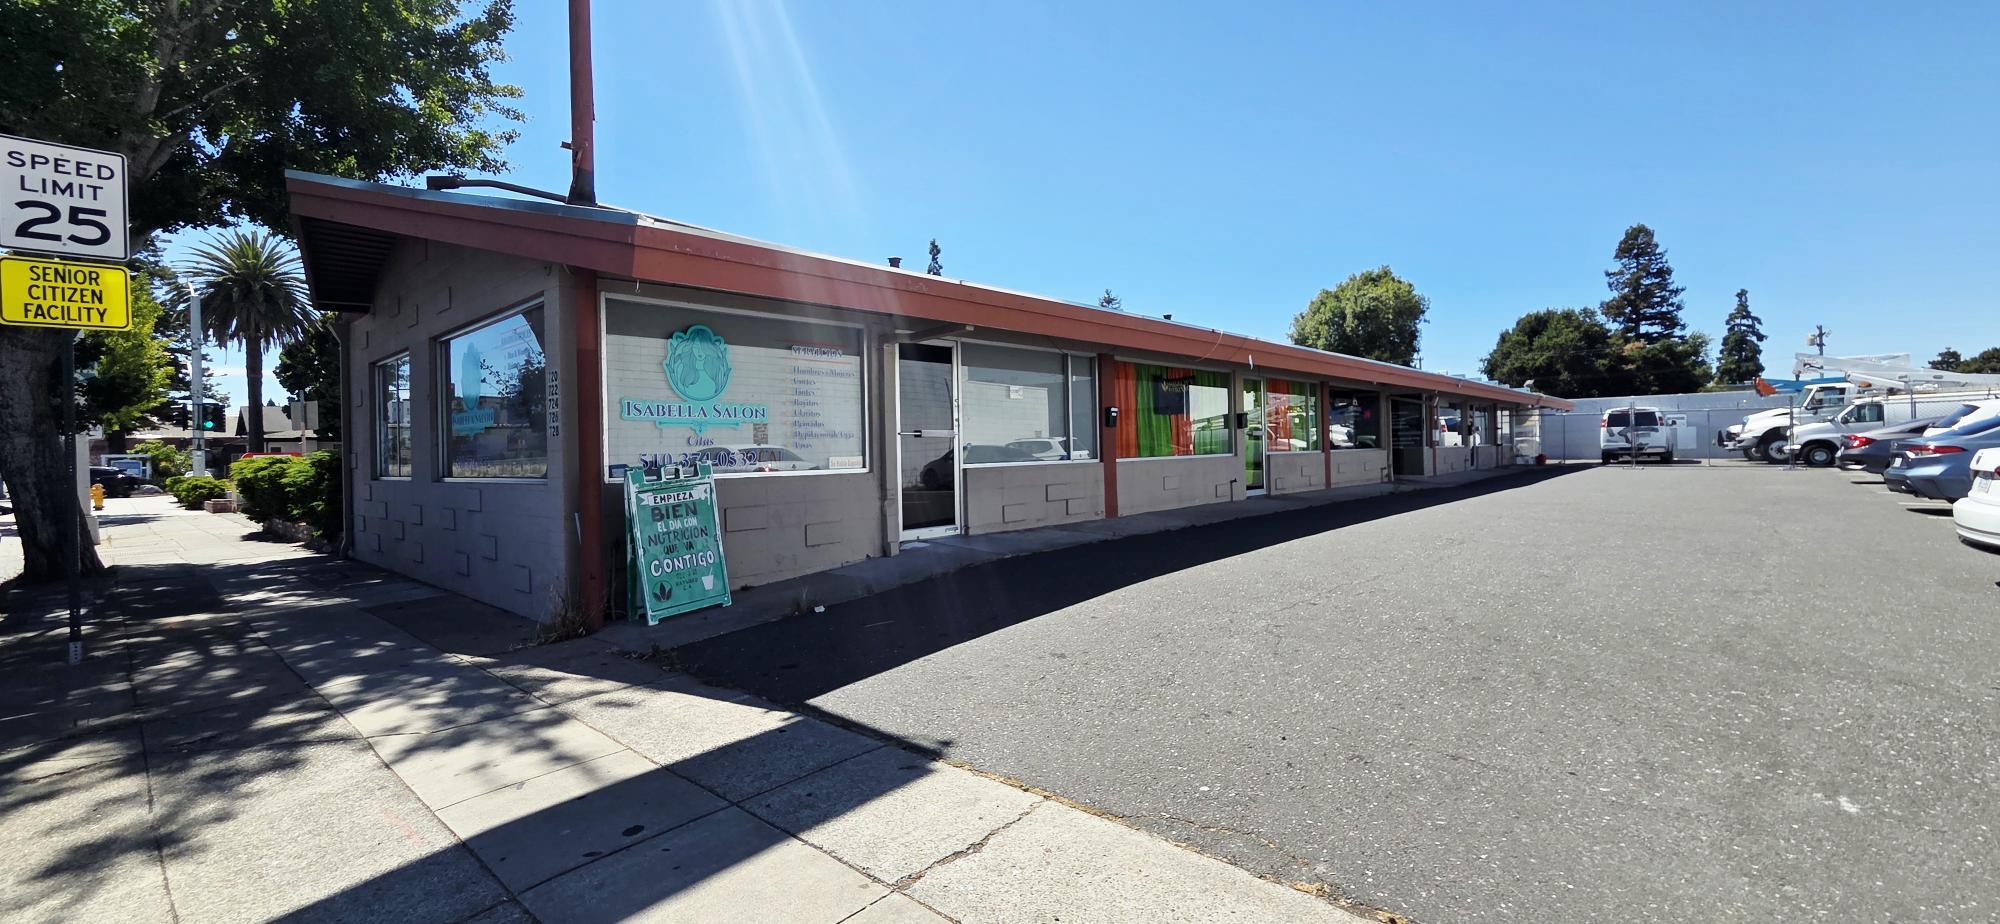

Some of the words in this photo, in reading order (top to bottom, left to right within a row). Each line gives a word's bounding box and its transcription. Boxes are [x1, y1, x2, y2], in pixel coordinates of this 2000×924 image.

[7, 150, 115, 181] SPEED
[20, 174, 104, 201] LIMIT
[14, 200, 111, 246] 25
[29, 265, 100, 287] SENIOR
[27, 284, 104, 305] CITIZEN
[23, 302, 108, 323] FACILITY
[549, 398, 558, 409] 724
[626, 401, 708, 418] ISABELLA
[712, 404, 766, 419] SALON
[687, 435, 714, 447] Citas
[653, 491, 694, 504] EMPIEZA
[651, 501, 698, 522] BIEN
[657, 520, 667, 532] EL
[669, 518, 682, 530] DIA
[684, 516, 698, 528] CON
[648, 525, 708, 547] NUTRICION
[683, 541, 694, 551] VA
[650, 550, 714, 577] CONTIGO
